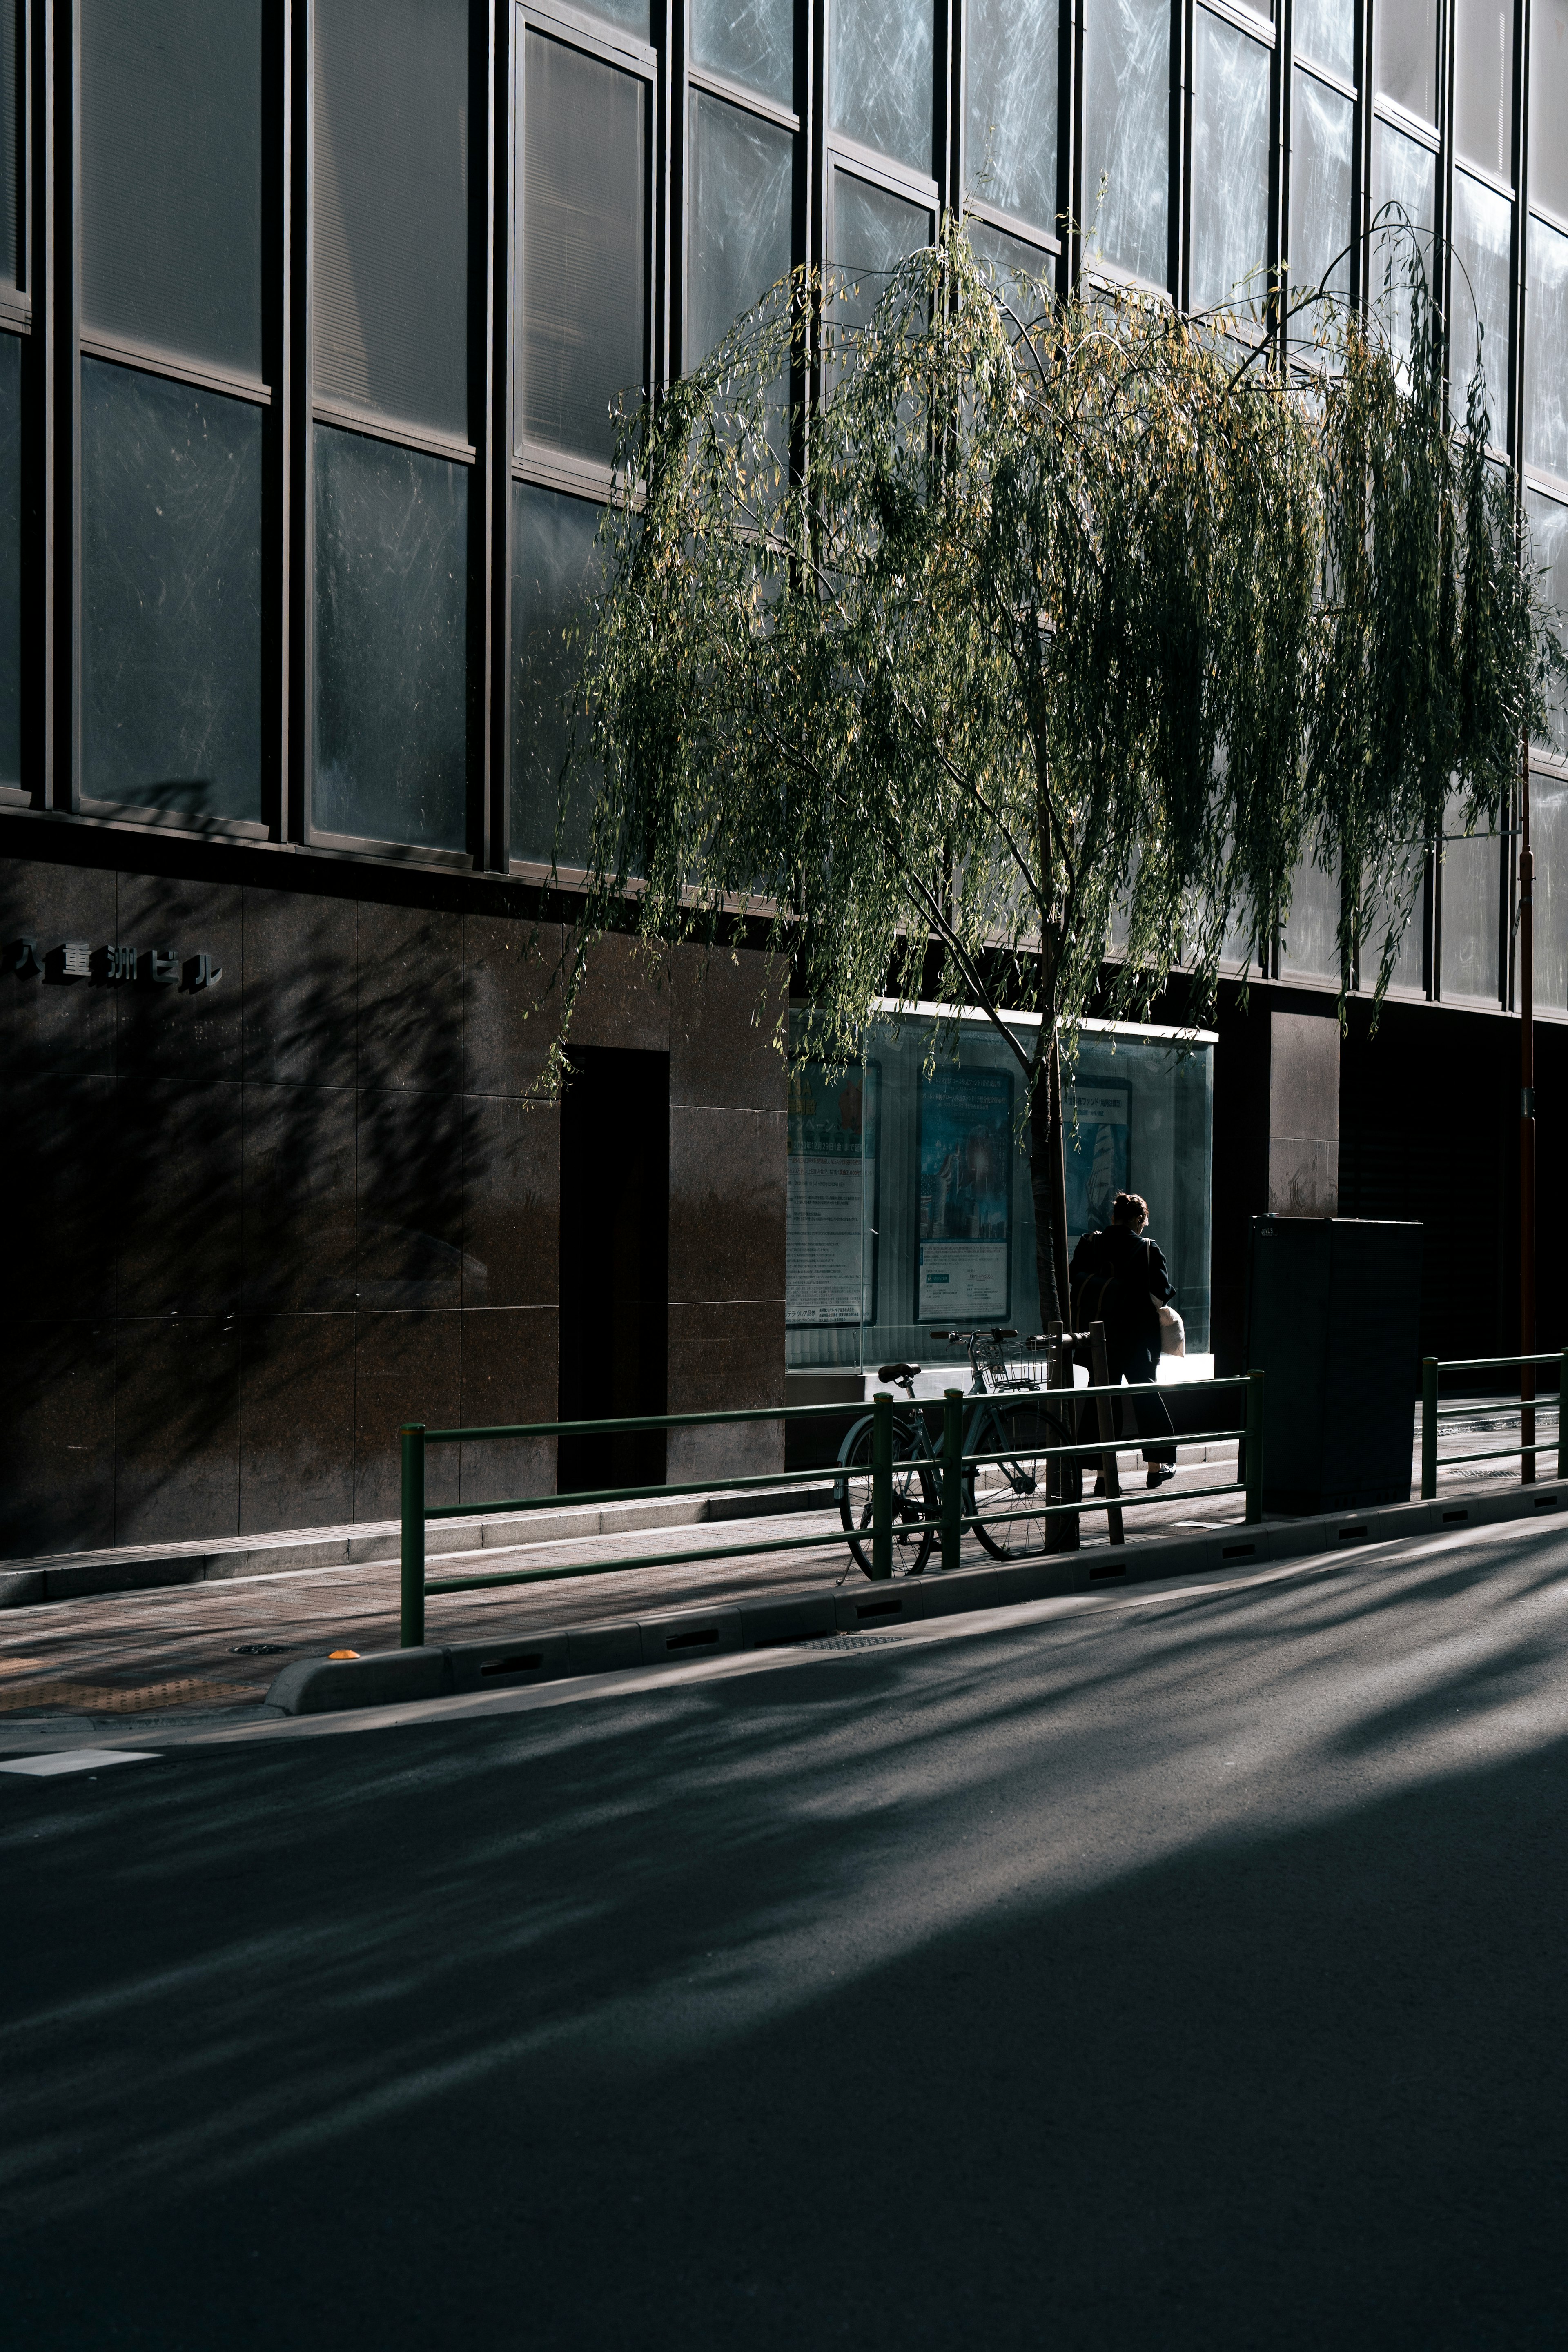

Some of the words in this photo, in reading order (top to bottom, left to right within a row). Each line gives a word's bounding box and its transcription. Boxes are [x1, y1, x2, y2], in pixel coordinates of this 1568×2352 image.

[13, 938, 223, 986] 八重洲ビル
[788, 1078, 813, 1097] ISA
